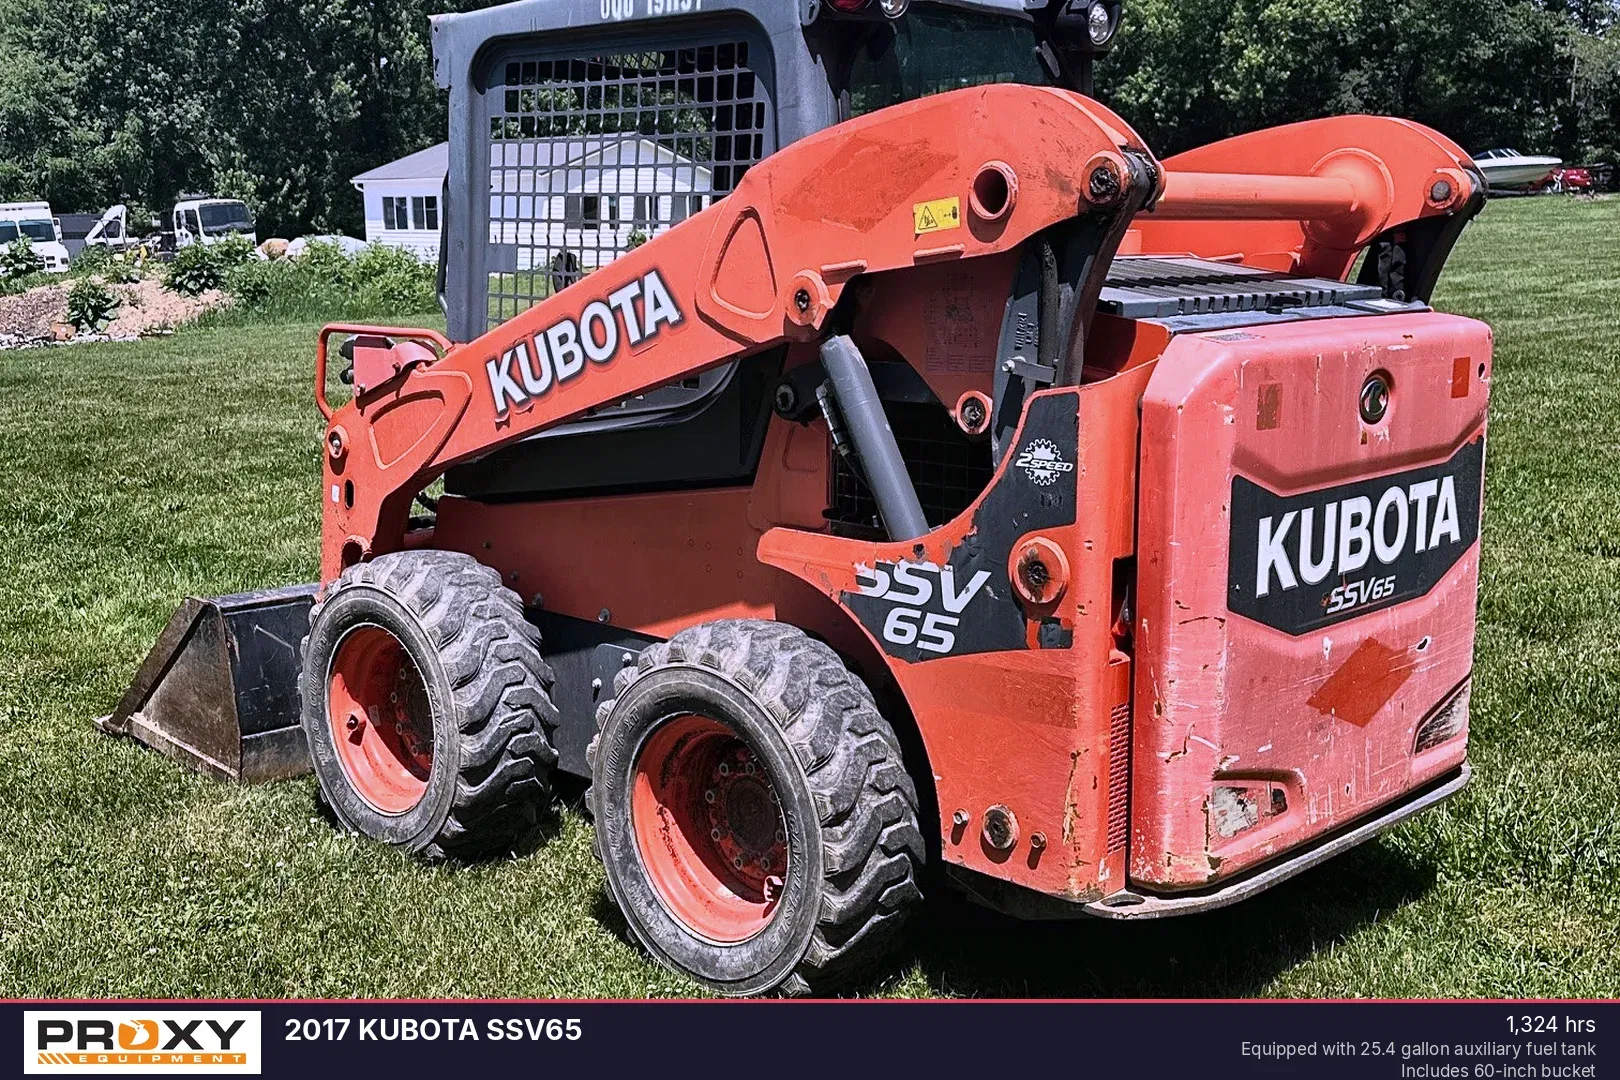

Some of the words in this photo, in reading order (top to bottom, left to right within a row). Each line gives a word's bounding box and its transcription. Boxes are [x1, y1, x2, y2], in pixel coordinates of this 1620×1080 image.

[486, 270, 681, 414] KUBOTA
[1256, 475, 1461, 599] KUBOTA
[883, 606, 960, 654] 65
[1326, 575, 1396, 614] SSV65
